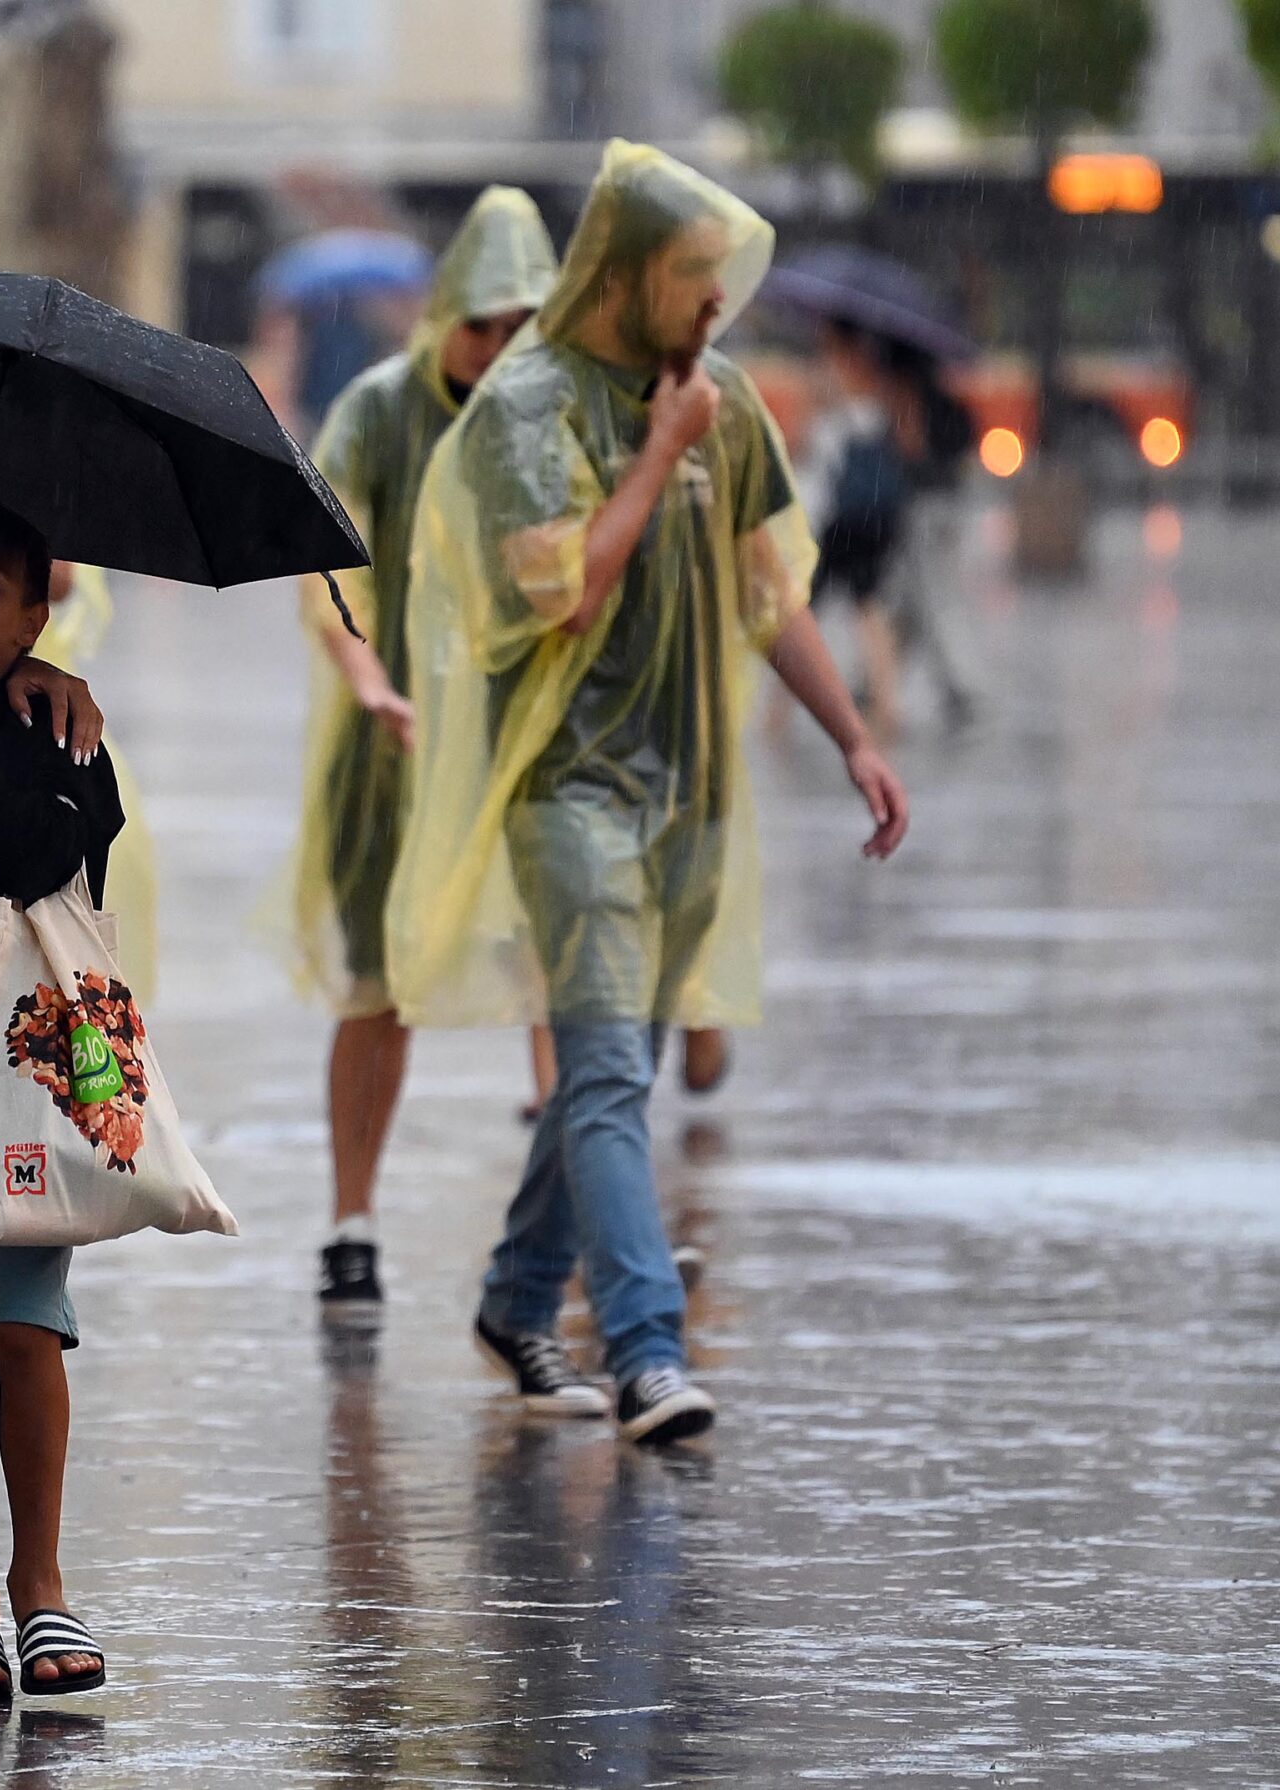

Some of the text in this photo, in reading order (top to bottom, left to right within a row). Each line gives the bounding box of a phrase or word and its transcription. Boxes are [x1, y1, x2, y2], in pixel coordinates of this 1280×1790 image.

[72, 1037, 106, 1075] BIO
[79, 1074, 117, 1096] PRIMO
[5, 1143, 46, 1153] Müller
[14, 1165, 36, 1183] M
